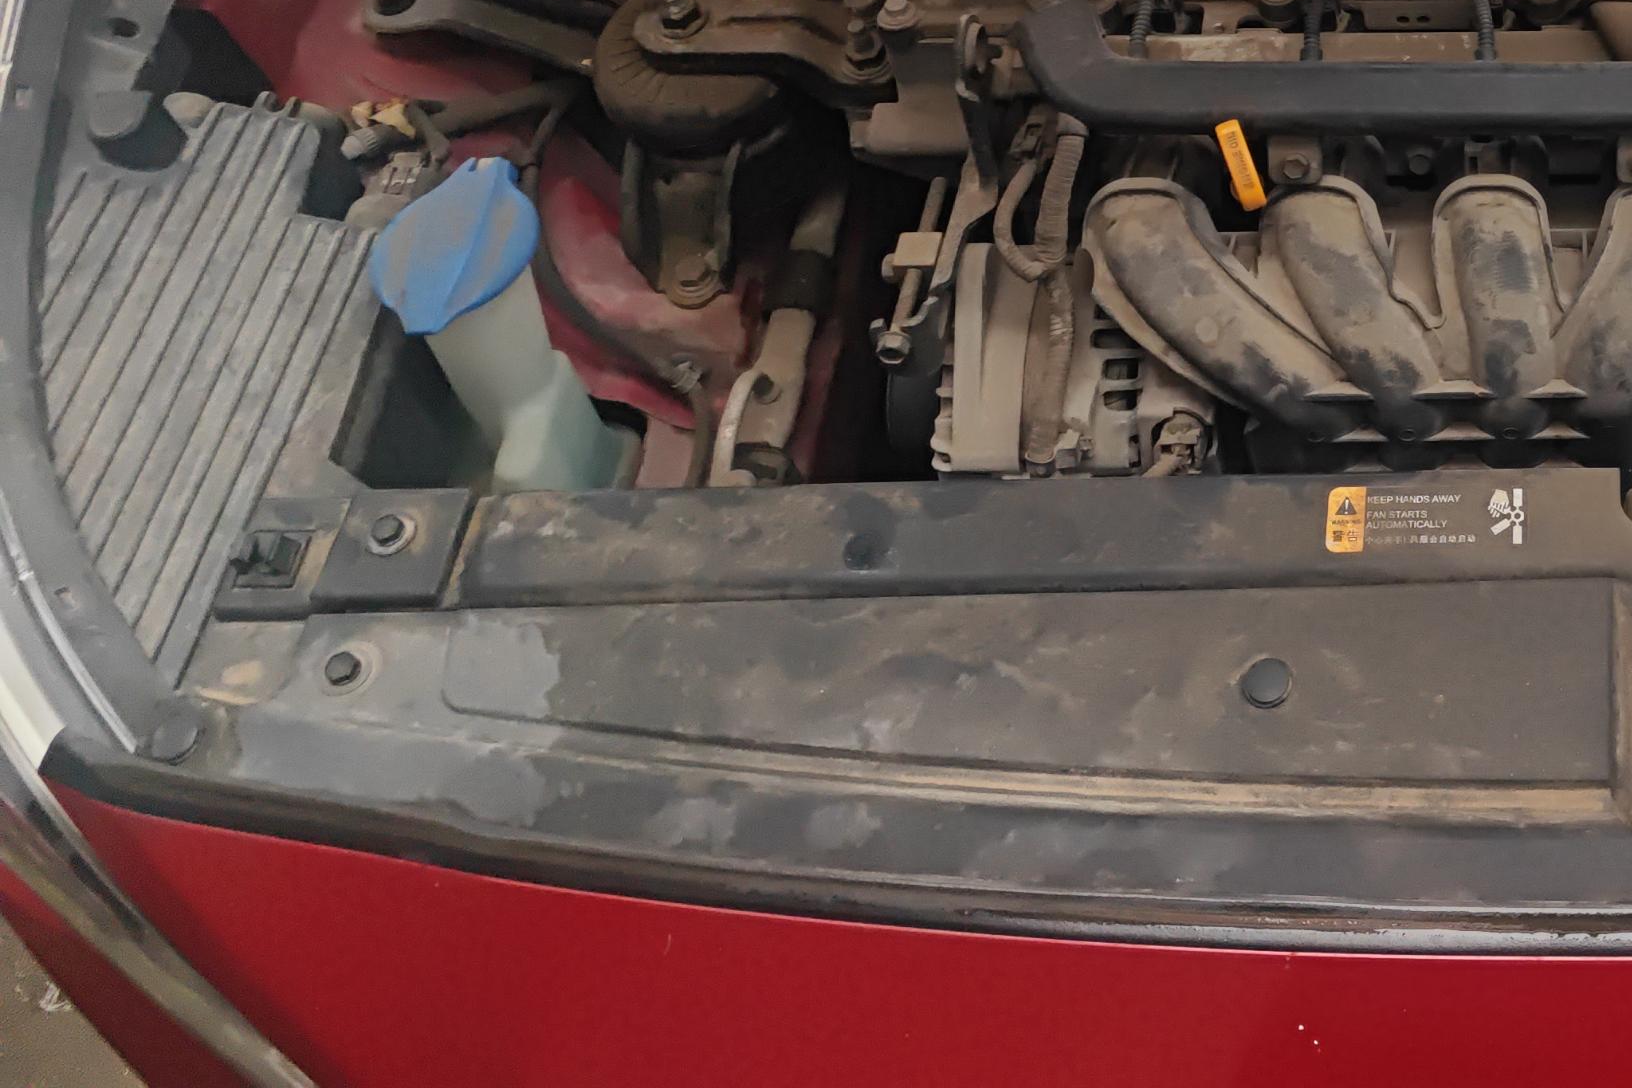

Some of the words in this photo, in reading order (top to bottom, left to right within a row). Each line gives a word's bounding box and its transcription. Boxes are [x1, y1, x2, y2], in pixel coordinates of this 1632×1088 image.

[1367, 495, 1394, 504] KEEP
[1395, 495, 1430, 504] HANDS
[1431, 494, 1462, 503] AWAY
[1366, 510, 1387, 519] FAN
[1389, 510, 1428, 519] STARTS
[1366, 520, 1448, 529] AUTOMATICALLY
